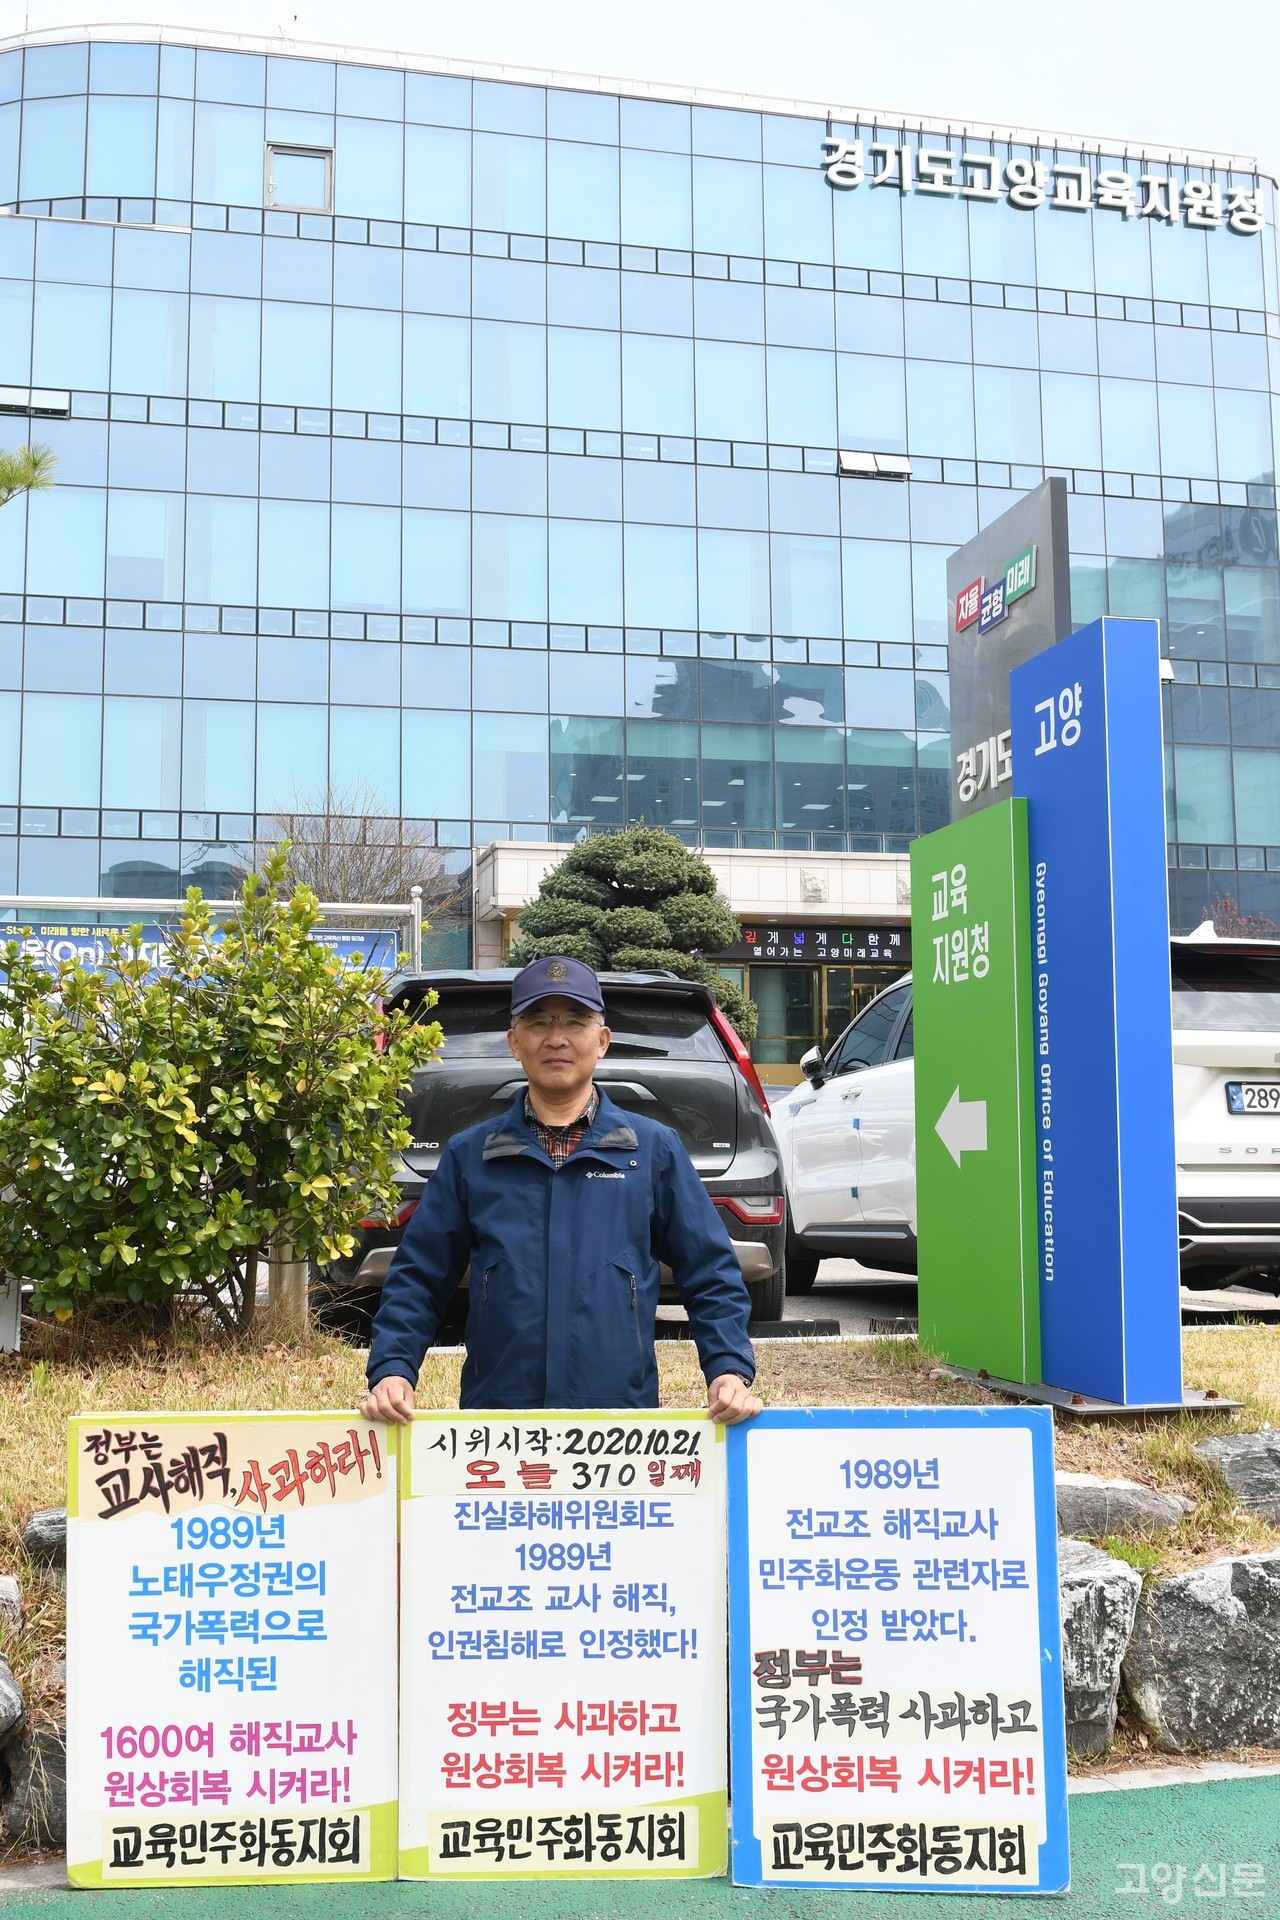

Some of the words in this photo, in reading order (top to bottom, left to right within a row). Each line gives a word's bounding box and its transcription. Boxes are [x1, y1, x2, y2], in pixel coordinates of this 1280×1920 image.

[824, 137, 1265, 233] 경기도고양교육지원청
[958, 584, 979, 625] 자율
[980, 585, 1003, 626] 균형
[1007, 560, 1030, 596] 미래
[1034, 682, 1083, 757] 고양
[931, 863, 968, 922] 교육
[41, 926, 68, 936] 미래를
[1035, 861, 1047, 965] Gyeonggi
[932, 920, 990, 985] 지원청
[1038, 972, 1050, 1056] Goyang
[1040, 1063, 1052, 1130] Office
[1043, 1139, 1053, 1162] of
[593, 1171, 625, 1179] Columbia
[1043, 1170, 1054, 1282] Education
[83, 1429, 164, 1466] 정부는
[95, 1432, 238, 1519] 교사해직,
[234, 1429, 383, 1513] 사과하라!
[465, 1460, 558, 1490] 오늘
[572, 1462, 636, 1490] 370
[647, 1459, 702, 1488] 일째
[840, 1458, 941, 1490] 1989년
[171, 1513, 286, 1551] 1989년
[454, 1500, 674, 1531] 진실화해위원회도
[786, 1508, 871, 1540] 전교조
[883, 1508, 999, 1541] 해직교사
[515, 1541, 612, 1571] 1989년
[759, 1558, 901, 1592] 민주화운동
[913, 1559, 1030, 1592] 관련자로
[128, 1560, 327, 1598] 노태우정권의
[451, 1584, 532, 1614] 전교조
[545, 1583, 601, 1614] 교사
[613, 1583, 676, 1617] 해직,
[128, 1609, 328, 1647] 국가폭력으로
[428, 1629, 566, 1661] 인권침해로
[579, 1628, 698, 1660] 인정했다!
[811, 1609, 868, 1641] 인정
[881, 1609, 977, 1643] 받았다.
[178, 1655, 277, 1693] 해직된
[753, 1649, 863, 1690] 정부는
[447, 1702, 541, 1737] 정부는
[554, 1701, 681, 1736] 사과하고
[755, 1691, 891, 1741] 국가폭력
[899, 1691, 1038, 1741] 사과하고
[101, 1721, 214, 1759] 1600여
[229, 1719, 357, 1757] 해직교사
[104, 1769, 232, 1807] 원상회복
[246, 1766, 351, 1805] 시켜라!
[440, 1752, 566, 1789] 원상회복
[581, 1750, 684, 1788] 시켜라!
[761, 1753, 902, 1793] 원상회복
[917, 1756, 1035, 1796] 시켜라!
[109, 1814, 360, 1869] 교육민주화동지회
[439, 1811, 686, 1863] 교육민주화동지회
[771, 1822, 1027, 1876] 교육민주화동지회
